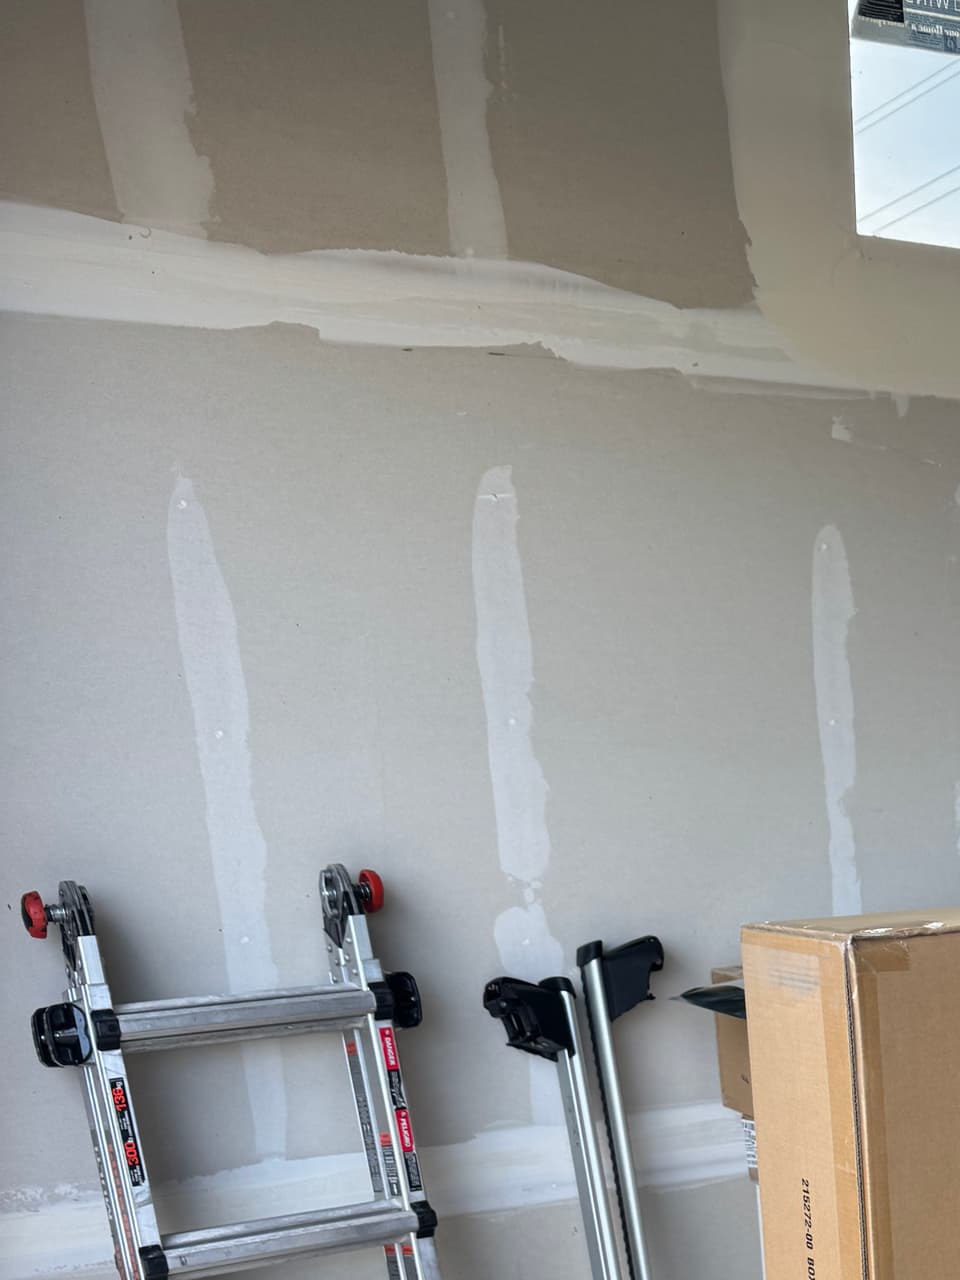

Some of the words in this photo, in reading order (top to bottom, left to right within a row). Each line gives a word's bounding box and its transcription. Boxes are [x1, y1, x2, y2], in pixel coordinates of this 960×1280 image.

[384, 1037, 397, 1066] DANGER
[112, 1087, 127, 1112] 136
[400, 1117, 411, 1148] PELIGRO
[124, 1141, 139, 1167] 300
[801, 1177, 814, 1250] 215272-00
